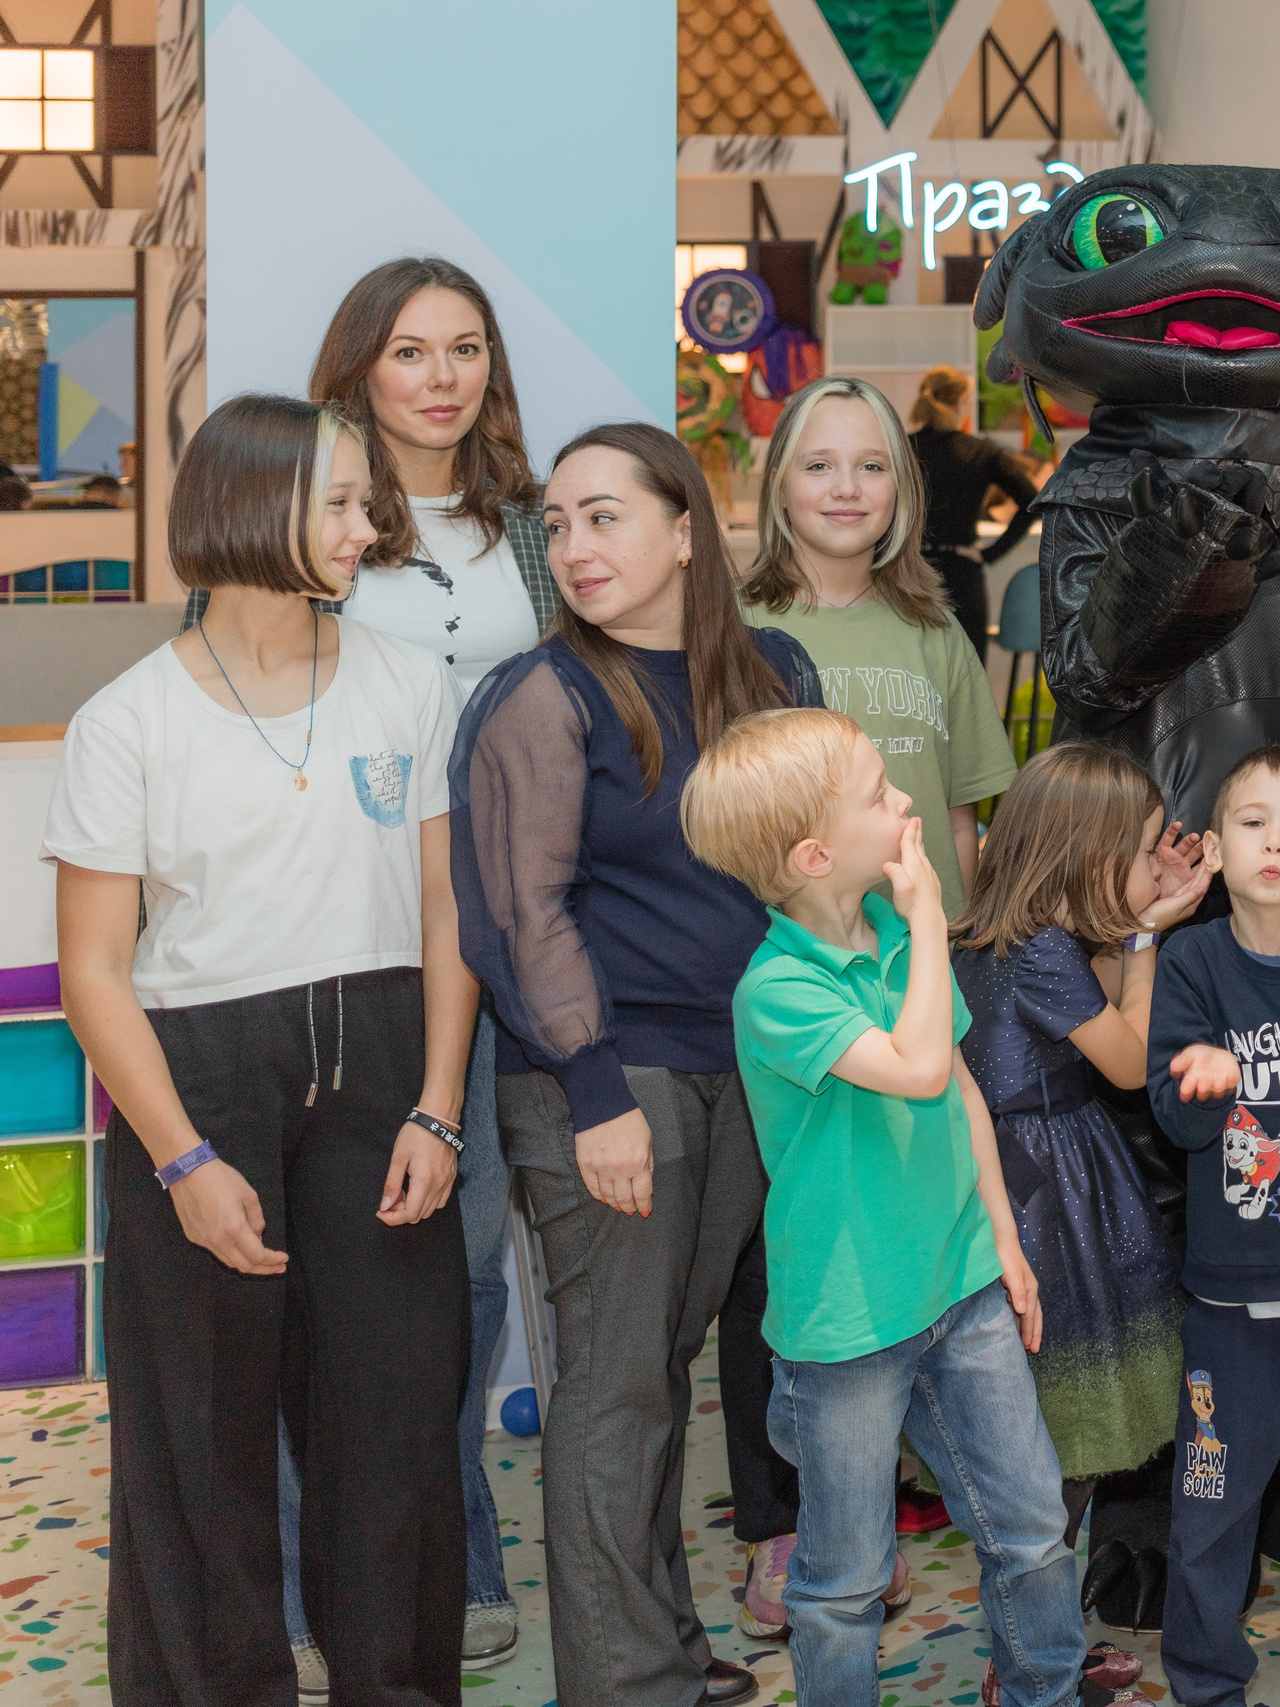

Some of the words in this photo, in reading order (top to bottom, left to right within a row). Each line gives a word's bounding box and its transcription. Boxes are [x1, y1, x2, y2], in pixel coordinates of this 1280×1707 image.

[856, 667, 949, 741] YORK
[888, 737, 924, 754] KIND
[1186, 1442, 1227, 1473] PAW
[1183, 1471, 1226, 1499] SOME
